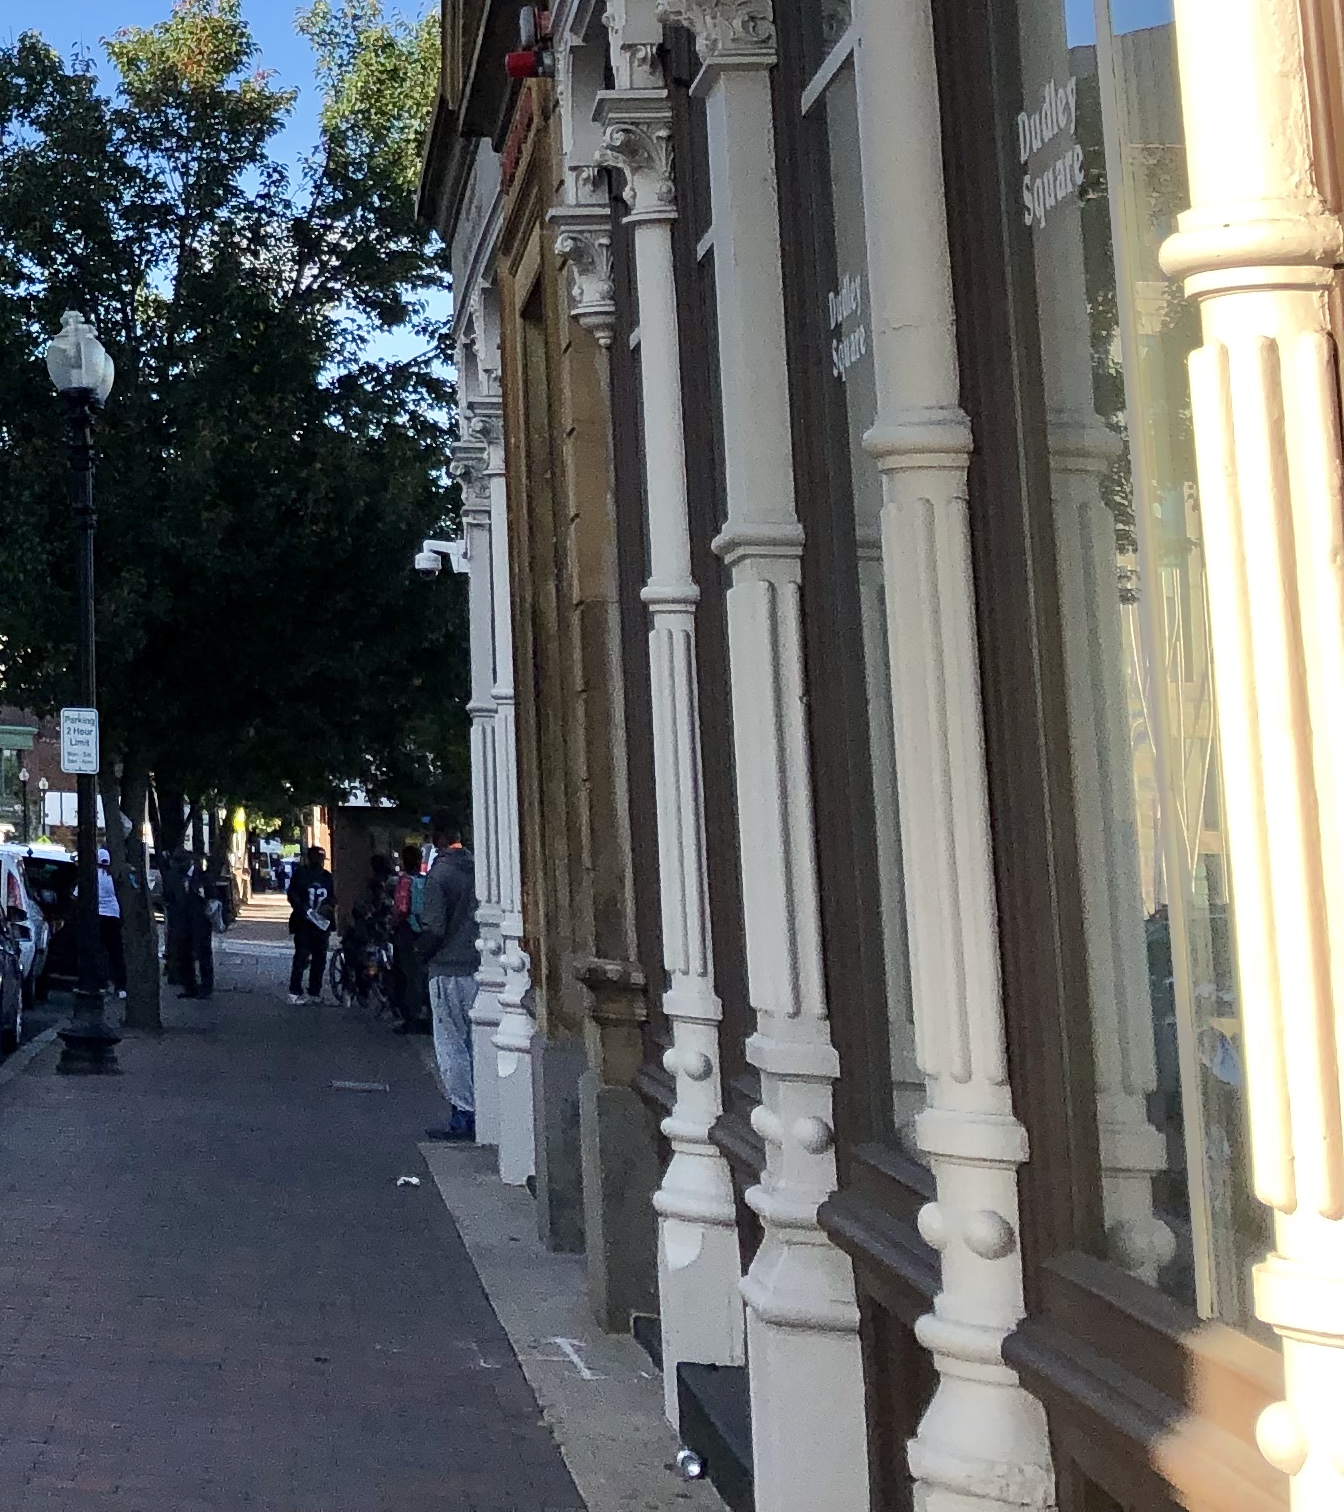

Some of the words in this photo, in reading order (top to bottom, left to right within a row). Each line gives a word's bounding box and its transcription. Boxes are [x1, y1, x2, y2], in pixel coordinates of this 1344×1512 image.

[1017, 76, 1077, 164] Dudley
[1022, 144, 1085, 229] Square
[64, 715, 95, 726] Parking
[66, 726, 72, 735] 2
[73, 727, 94, 736] Hour
[69, 738, 90, 747] Limit
